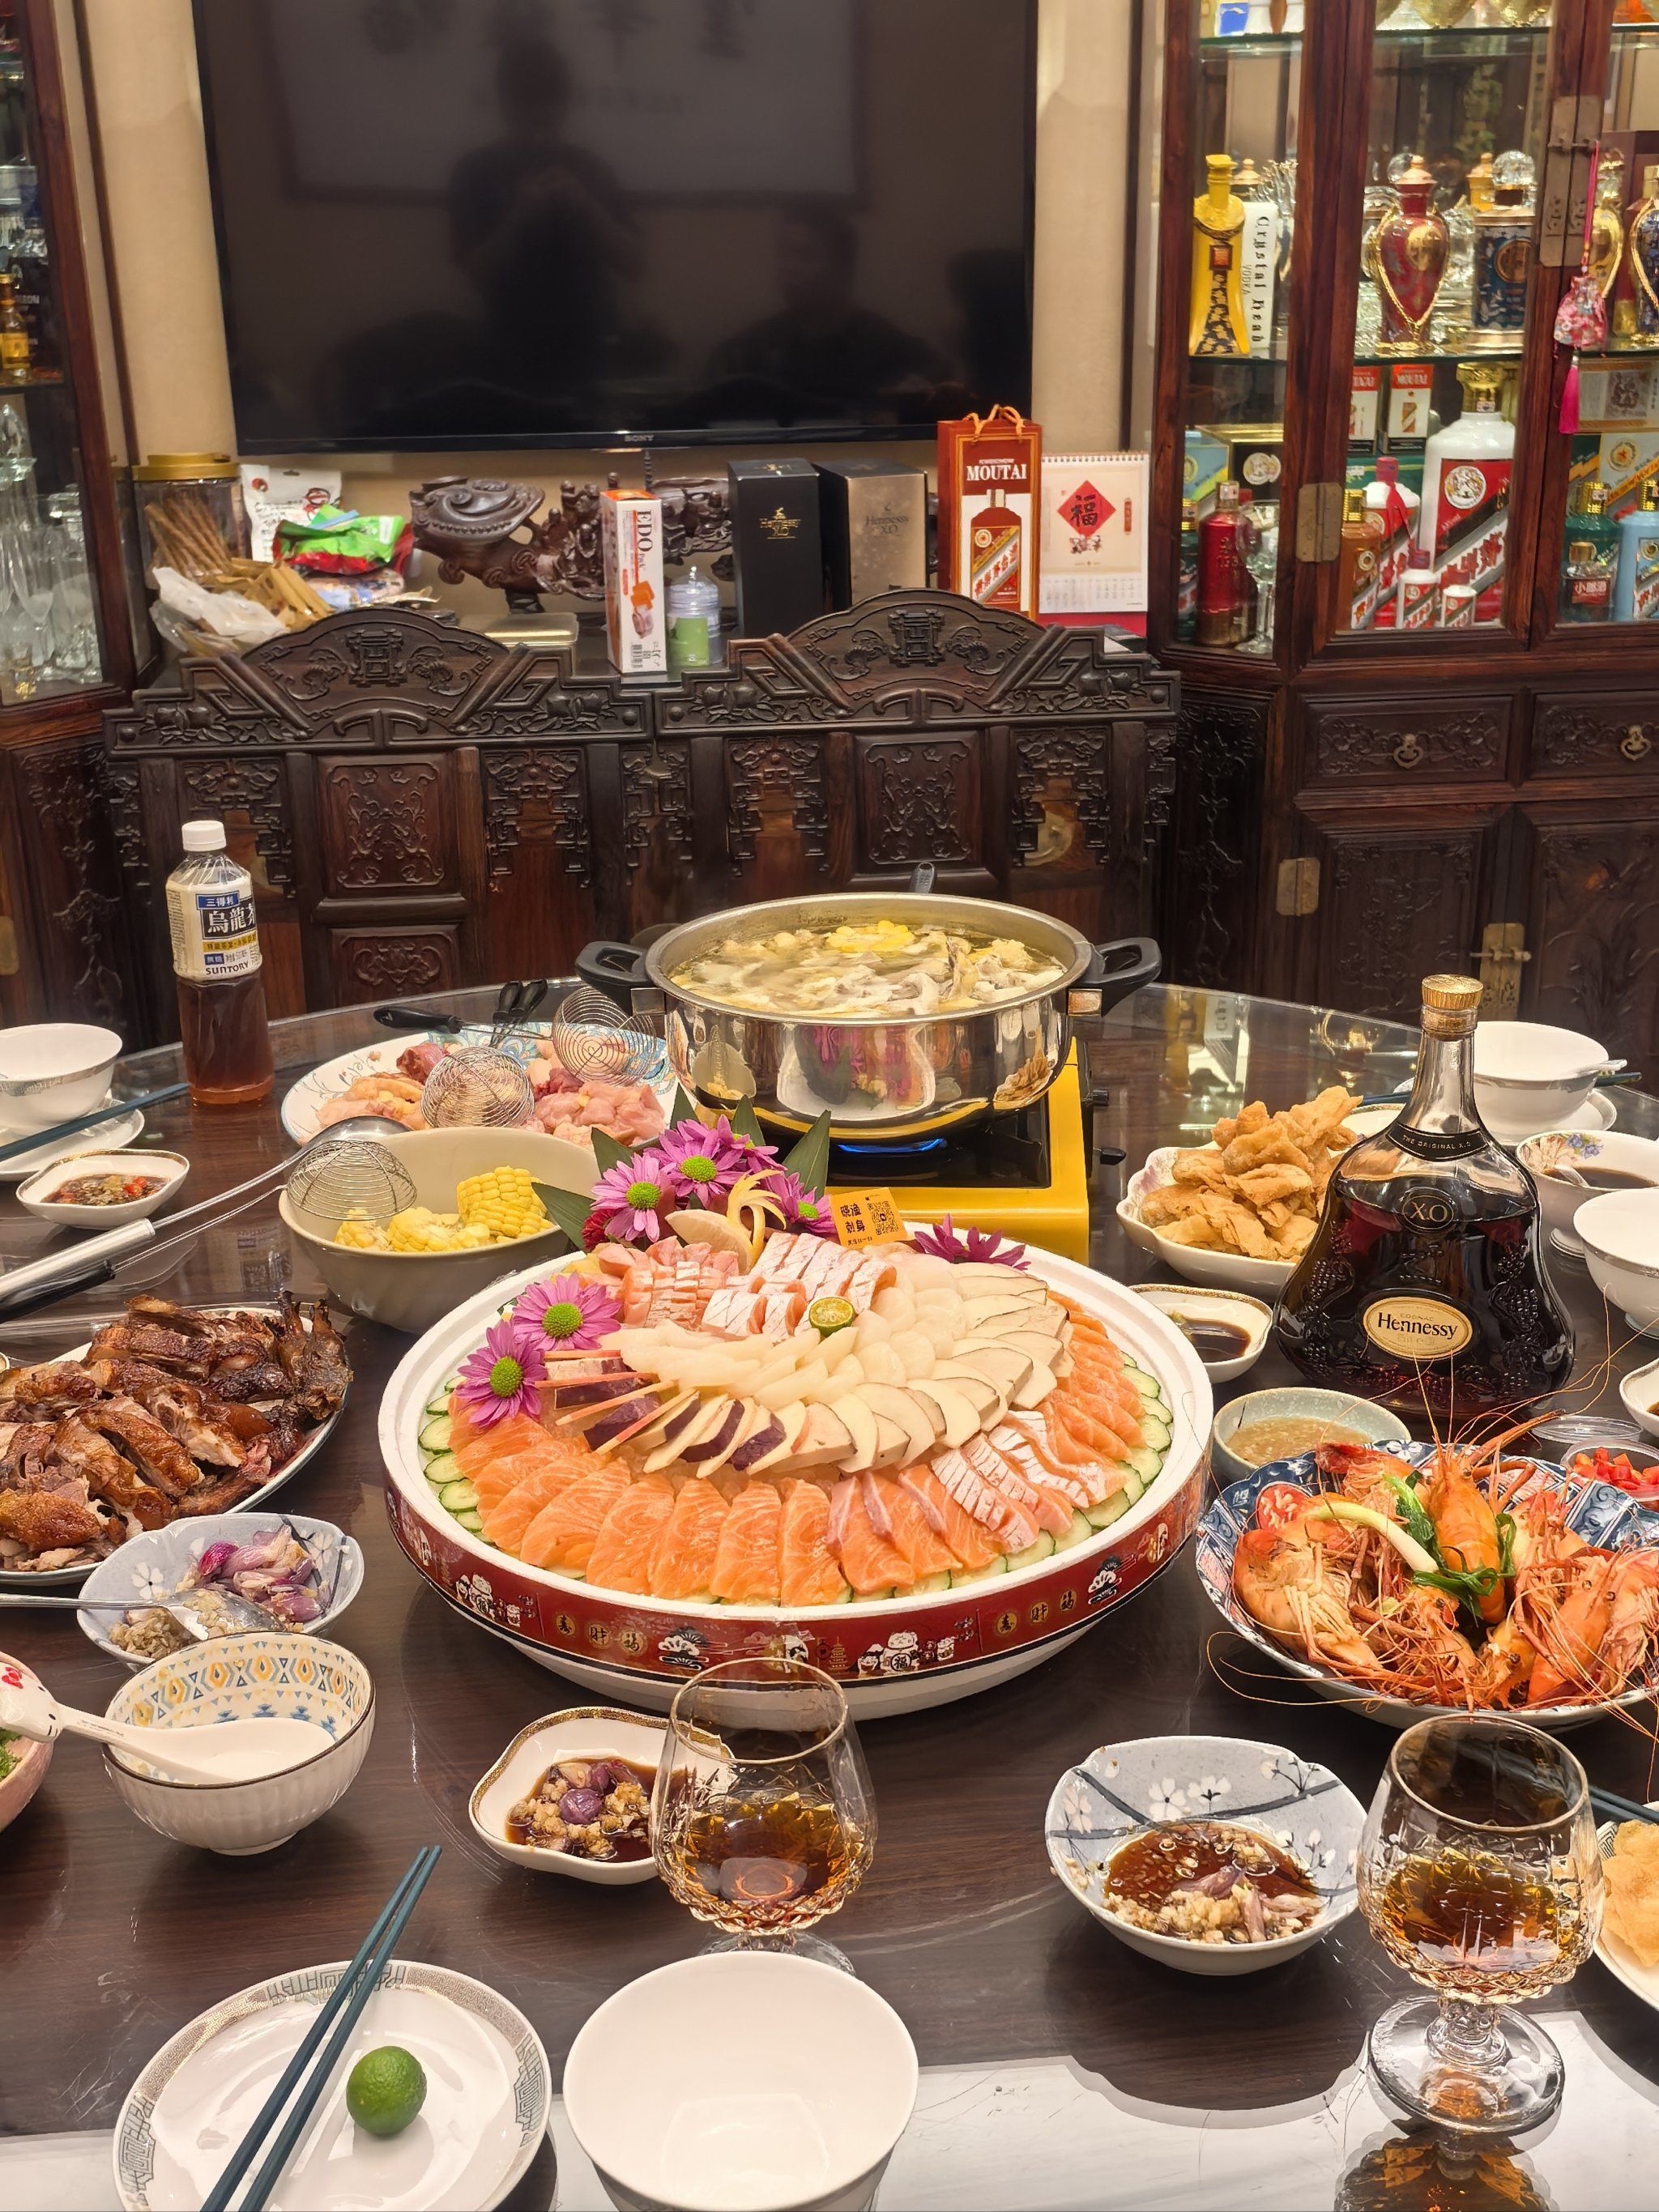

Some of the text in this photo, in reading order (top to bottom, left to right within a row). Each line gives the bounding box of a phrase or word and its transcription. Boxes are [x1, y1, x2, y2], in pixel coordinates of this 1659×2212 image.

[1251, 215, 1270, 343] Crystal Head
[966, 464, 1027, 481] MOUTAI
[1070, 494, 1098, 526] 福
[637, 510, 653, 552] EDO
[1402, 1135, 1415, 1144] THE
[1418, 1140, 1456, 1150] ORIGINAL
[1377, 1312, 1458, 1340] Hennessy
